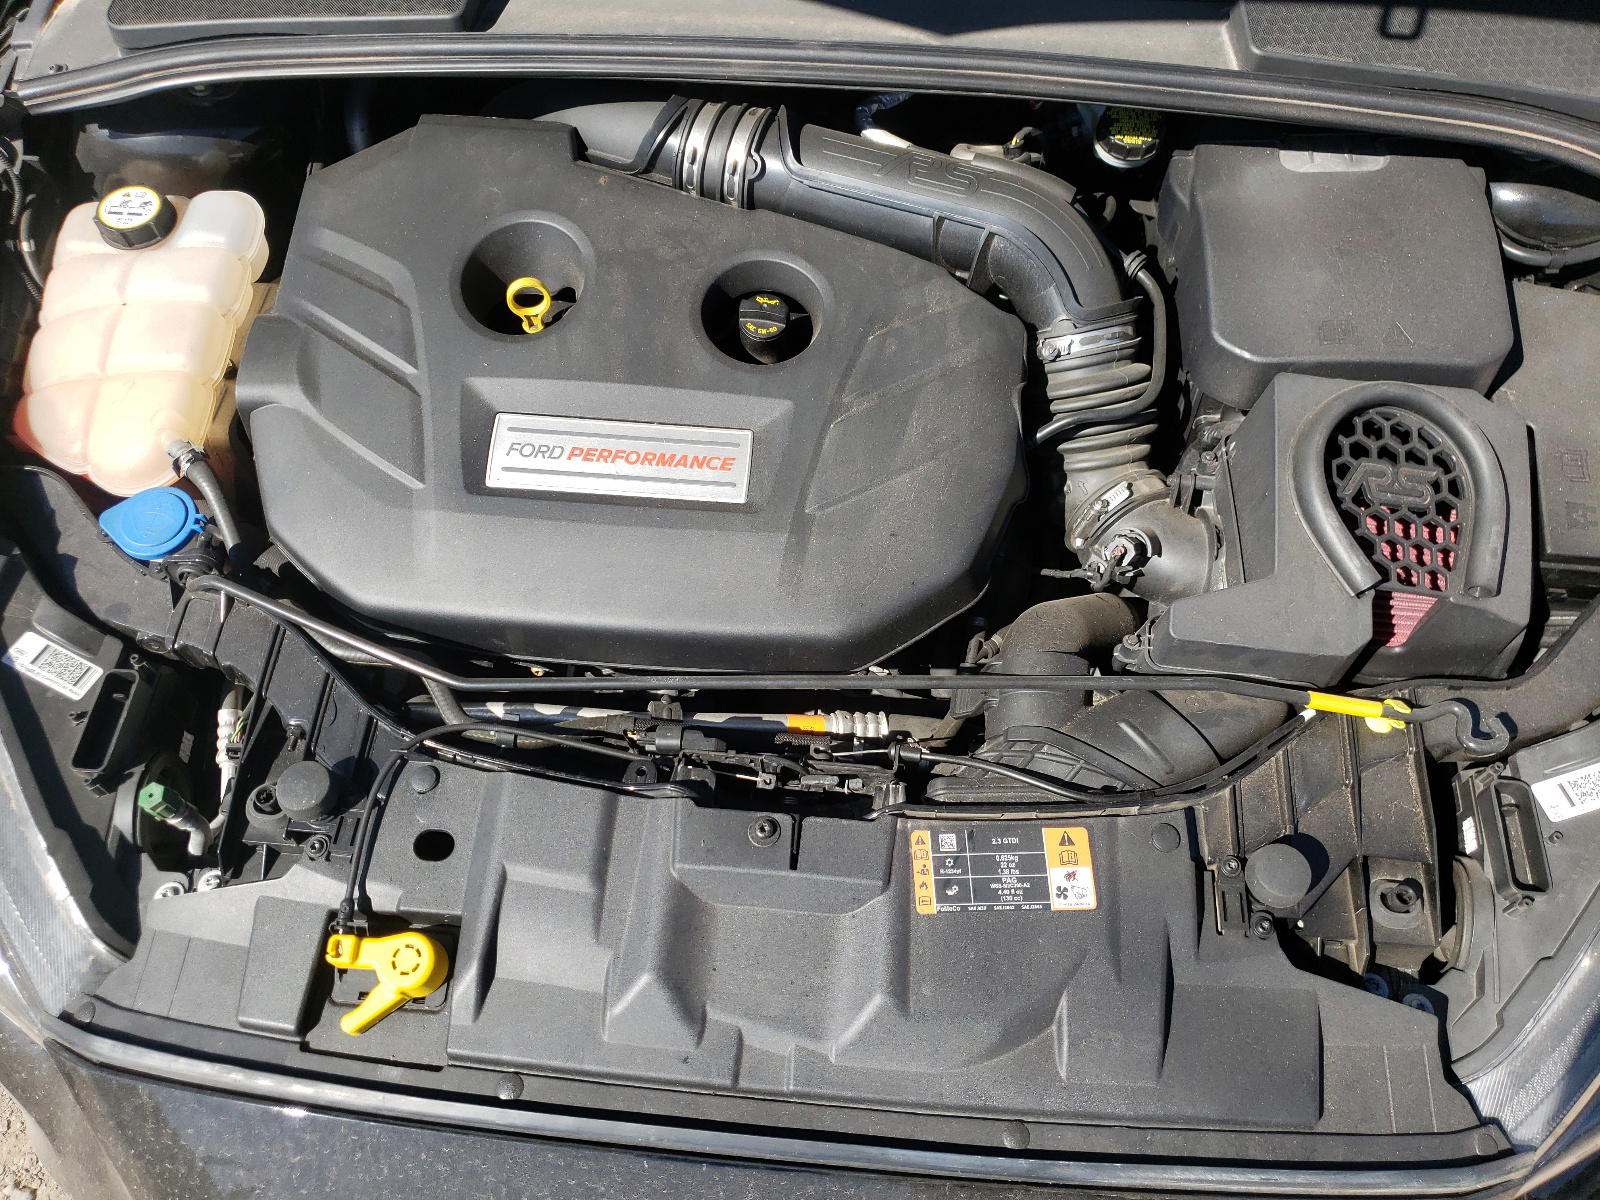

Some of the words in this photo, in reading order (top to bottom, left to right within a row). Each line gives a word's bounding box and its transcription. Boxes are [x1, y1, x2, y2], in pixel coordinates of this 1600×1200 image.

[506, 442, 564, 460] FORD
[567, 446, 737, 472] PERFORMANCE
[1342, 462, 1439, 505] RS
